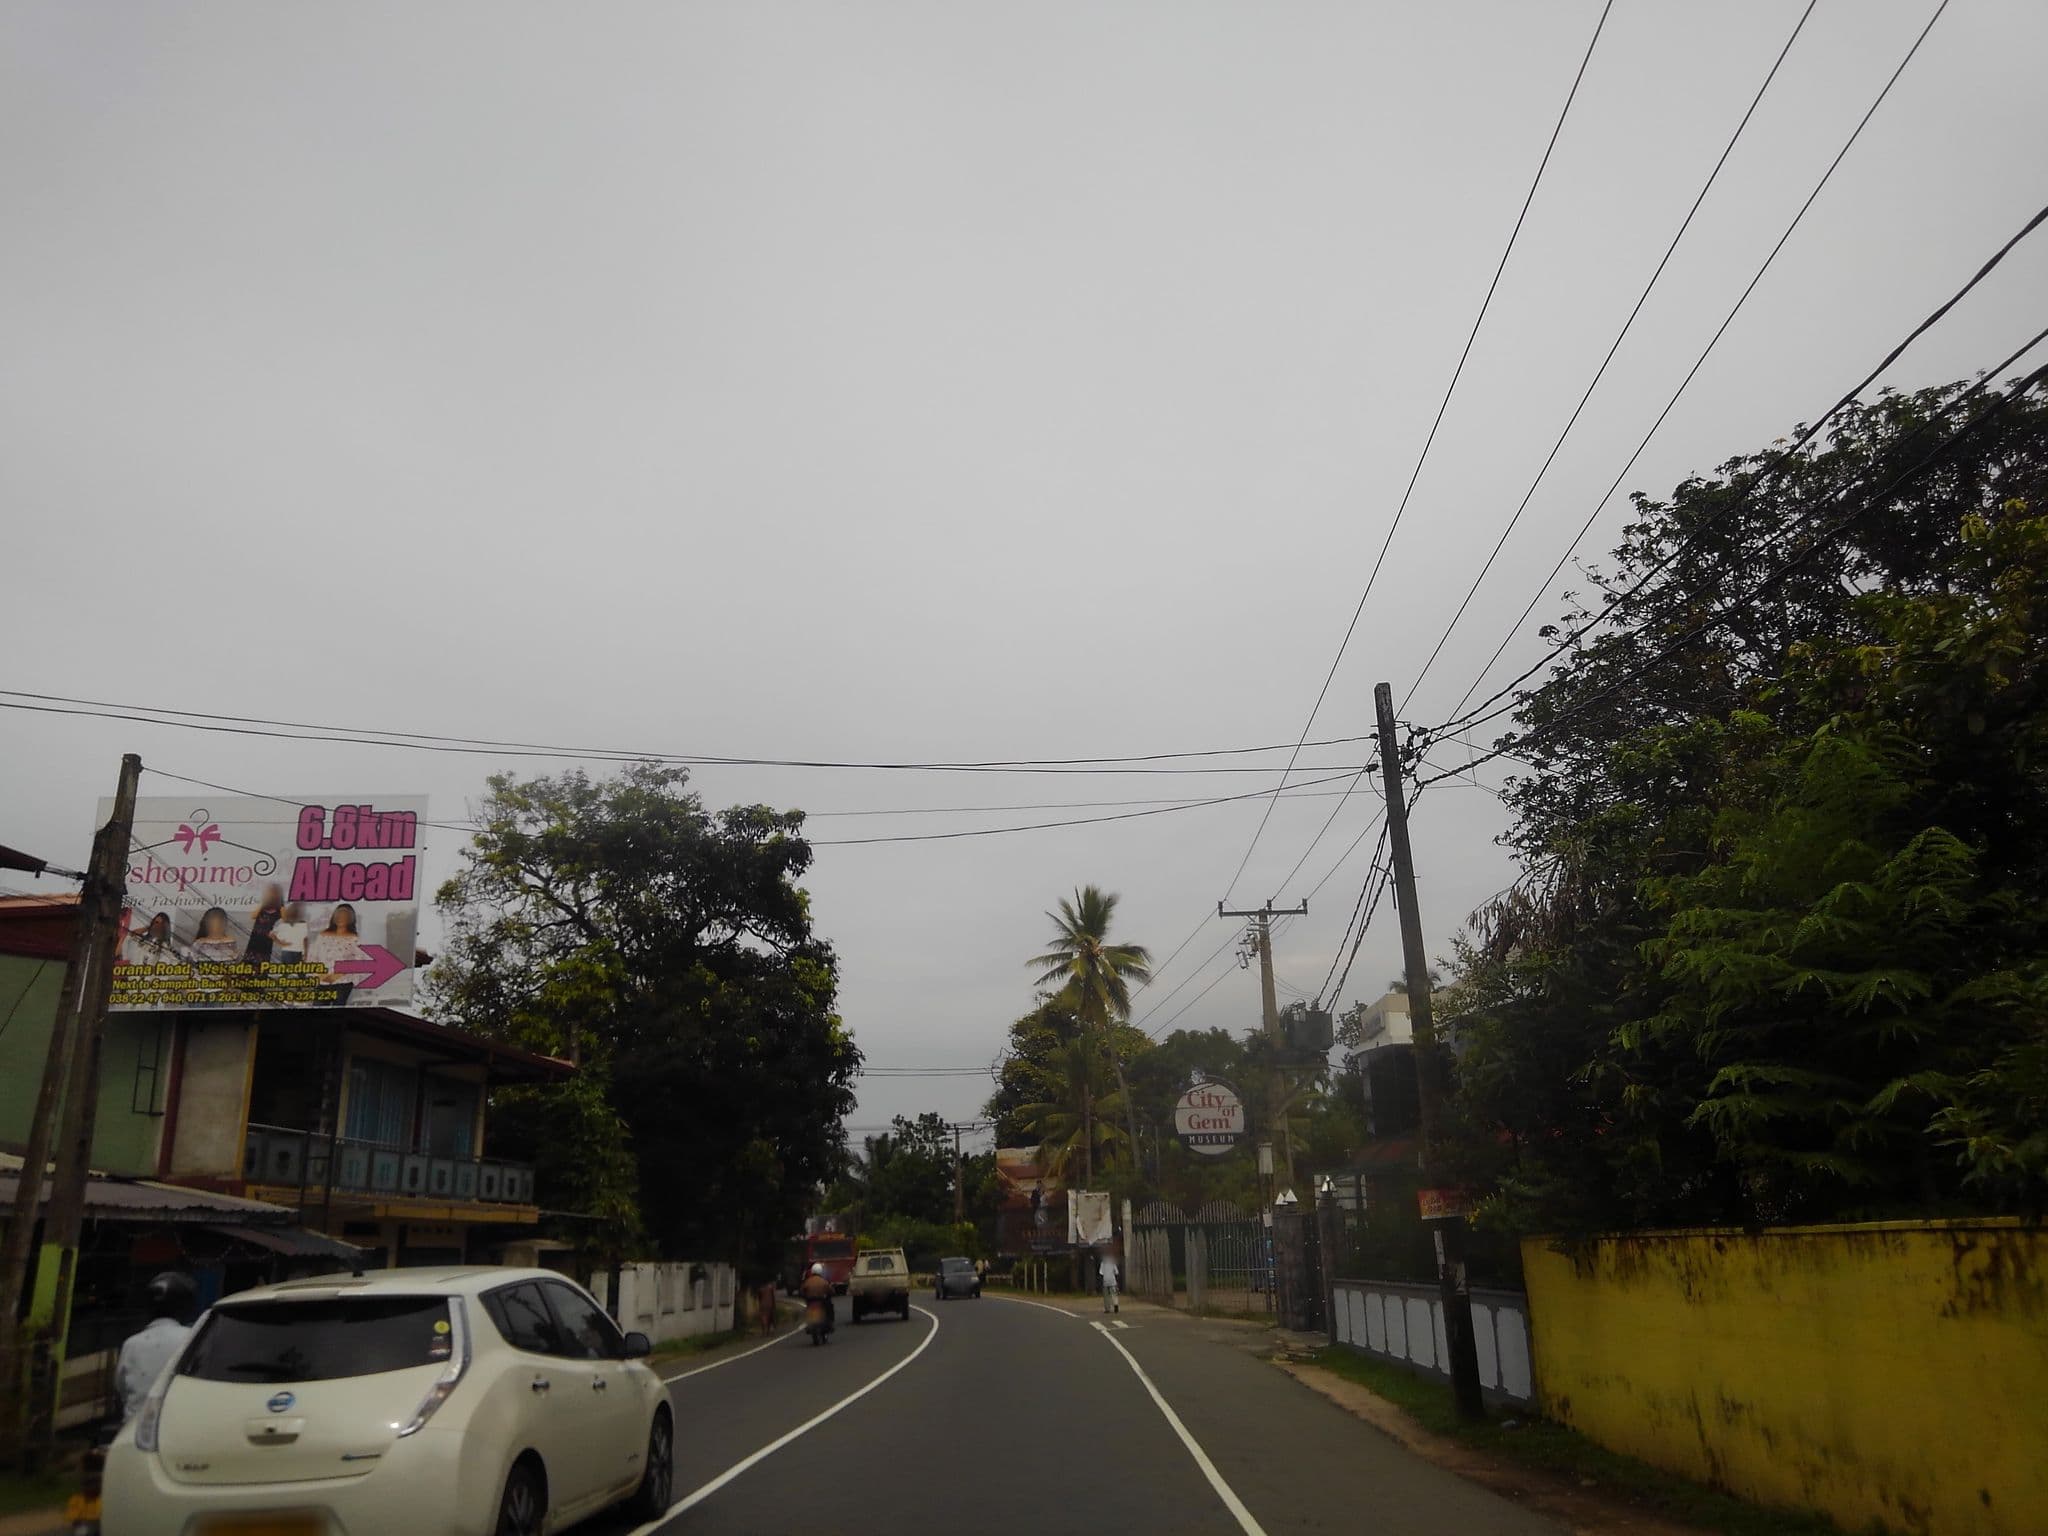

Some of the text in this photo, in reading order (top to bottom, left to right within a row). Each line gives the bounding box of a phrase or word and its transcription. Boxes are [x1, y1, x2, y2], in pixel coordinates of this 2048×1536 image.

[296, 804, 418, 851] 6.8km
[129, 856, 253, 892] shopimo
[288, 855, 417, 902] Ahead
[150, 894, 206, 908] Fashion
[113, 964, 152, 977] orana
[259, 960, 329, 975] Panadura.
[151, 977, 199, 991] Sampath
[108, 992, 129, 1004] 038
[131, 992, 145, 1004] 22
[146, 991, 161, 1004] 47
[186, 990, 207, 1003] 071
[208, 990, 217, 1002] 9
[219, 990, 238, 1003] 201
[285, 989, 295, 1002] 8
[295, 989, 316, 1003] 324
[317, 988, 338, 1002] 224
[1187, 1089, 1225, 1112] City
[1222, 1103, 1239, 1117] of
[1187, 1113, 1232, 1130] Gem
[1189, 1135, 1234, 1144] MUSEUM
